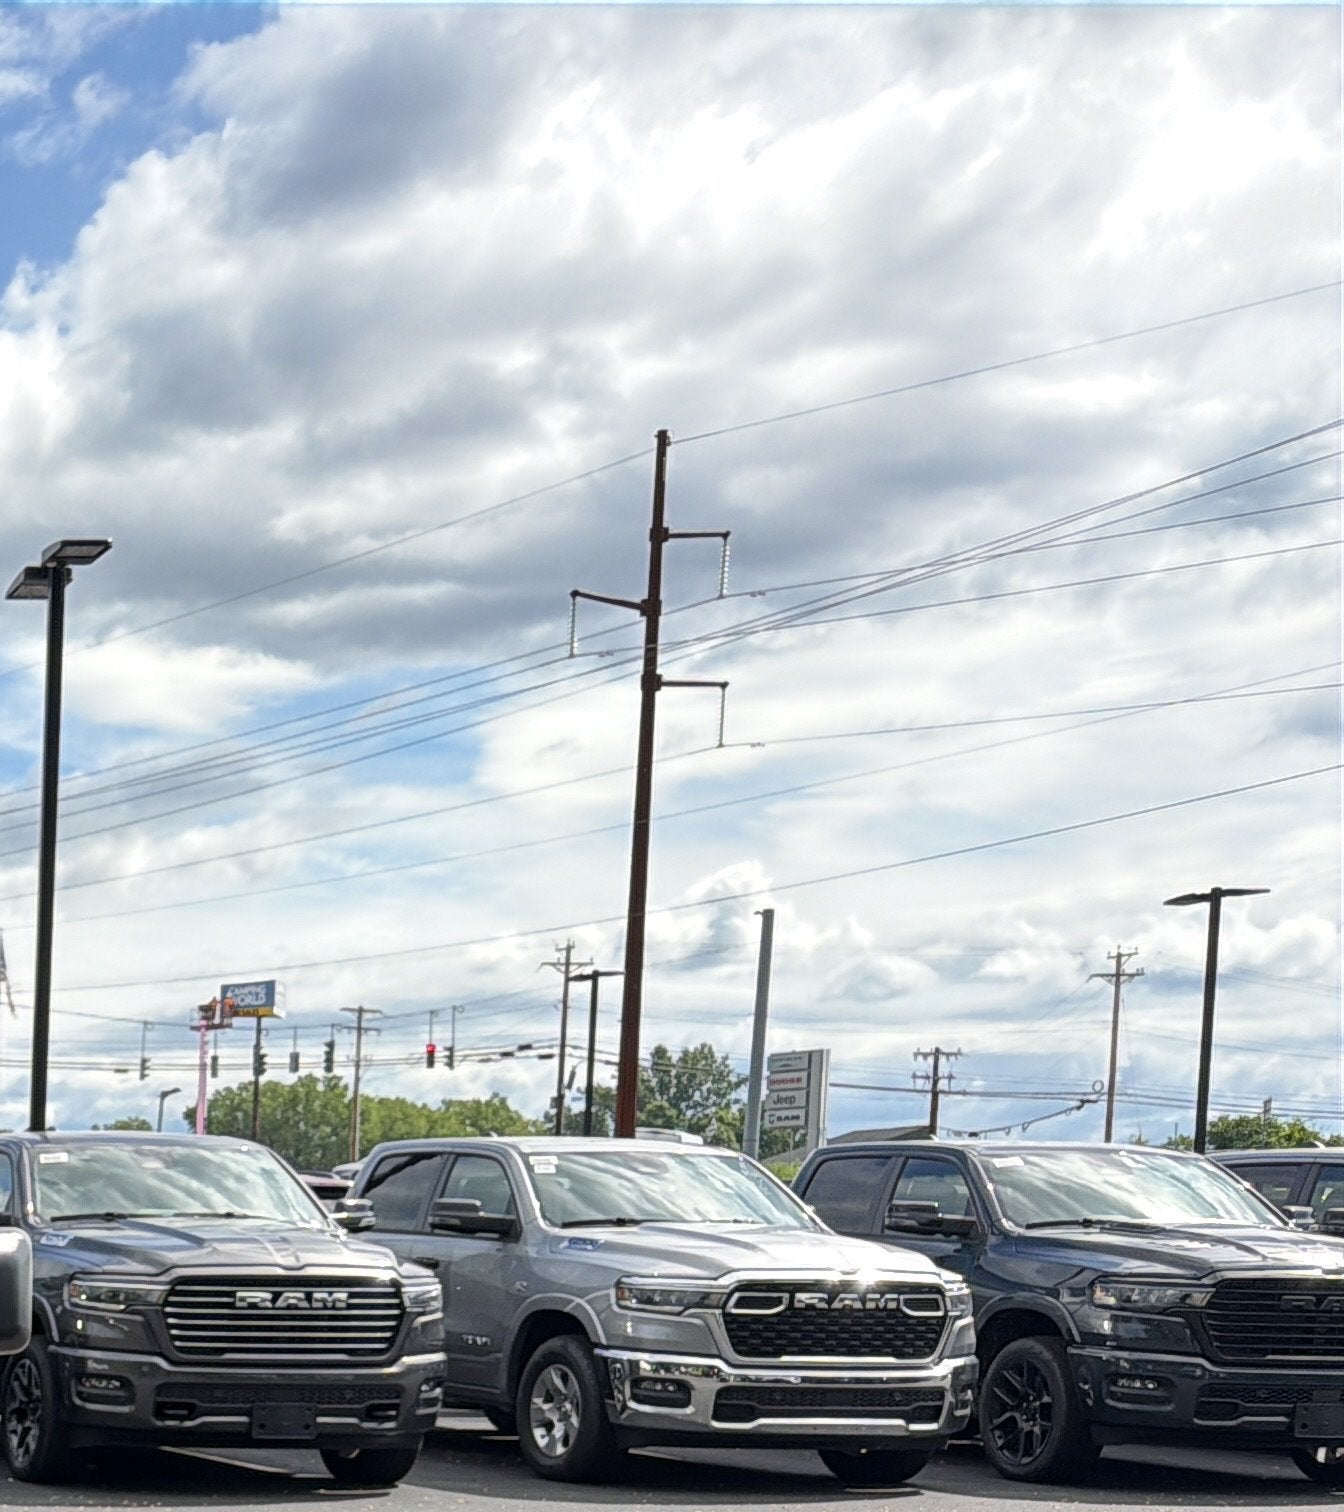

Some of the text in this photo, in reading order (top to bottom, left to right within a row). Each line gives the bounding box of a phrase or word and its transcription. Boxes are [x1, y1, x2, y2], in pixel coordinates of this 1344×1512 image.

[773, 1094, 796, 1105] Jeep
[234, 1291, 349, 1309] RAM
[793, 1292, 899, 1310] RAM
